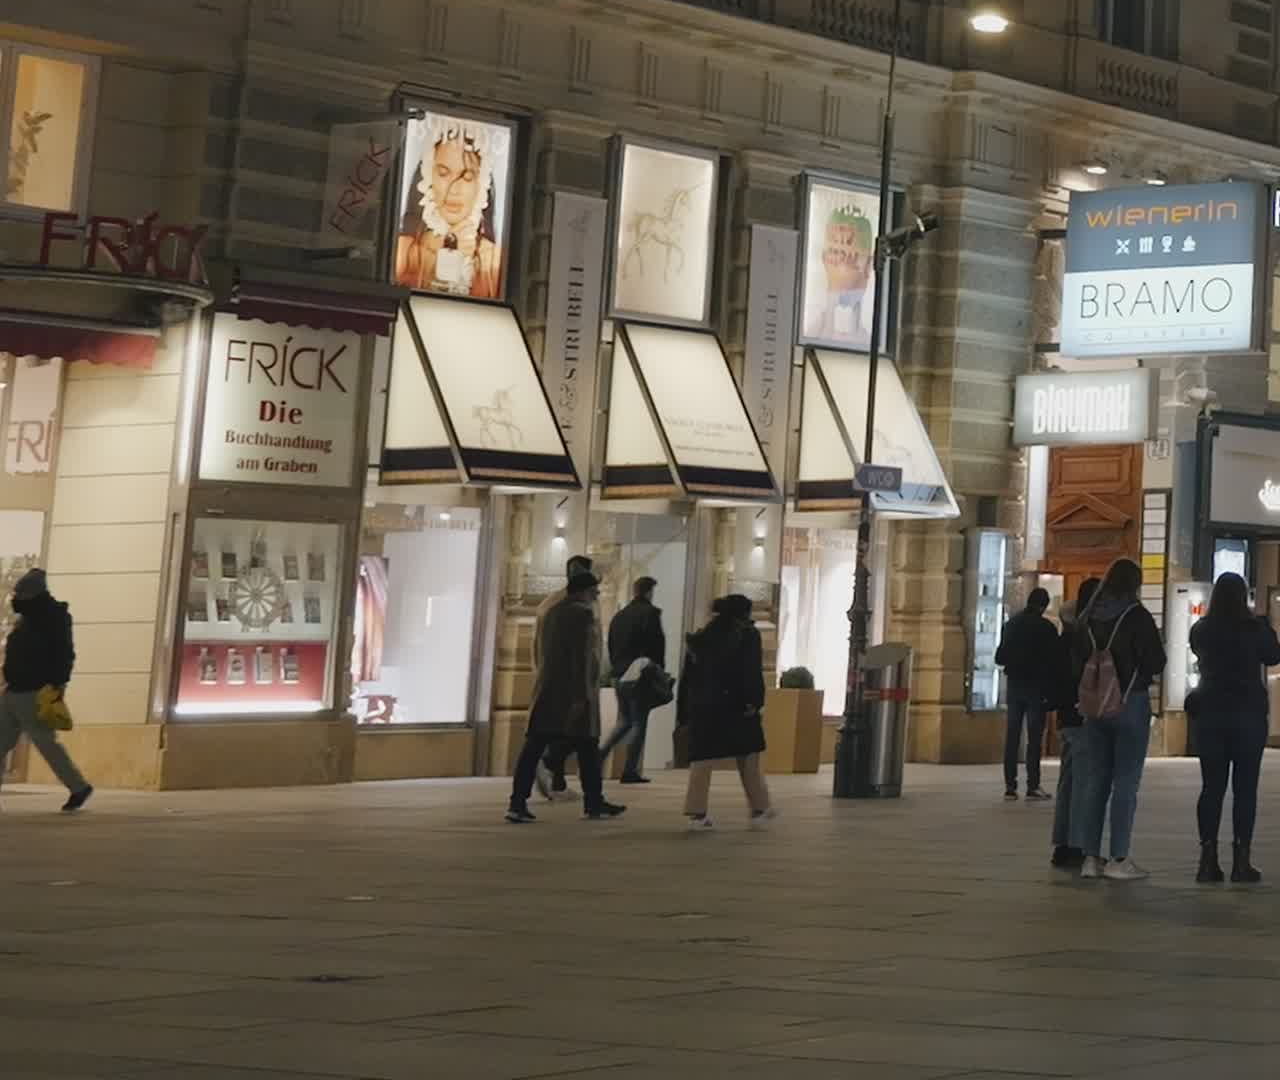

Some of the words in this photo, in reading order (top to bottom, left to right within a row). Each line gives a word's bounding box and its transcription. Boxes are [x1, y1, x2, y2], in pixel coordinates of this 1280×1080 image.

[1080, 277, 1233, 319] BRAMO
[258, 399, 304, 425] Die
[224, 430, 334, 454] Buchhandlung
[236, 458, 260, 471] am
[264, 457, 318, 474] Graben
